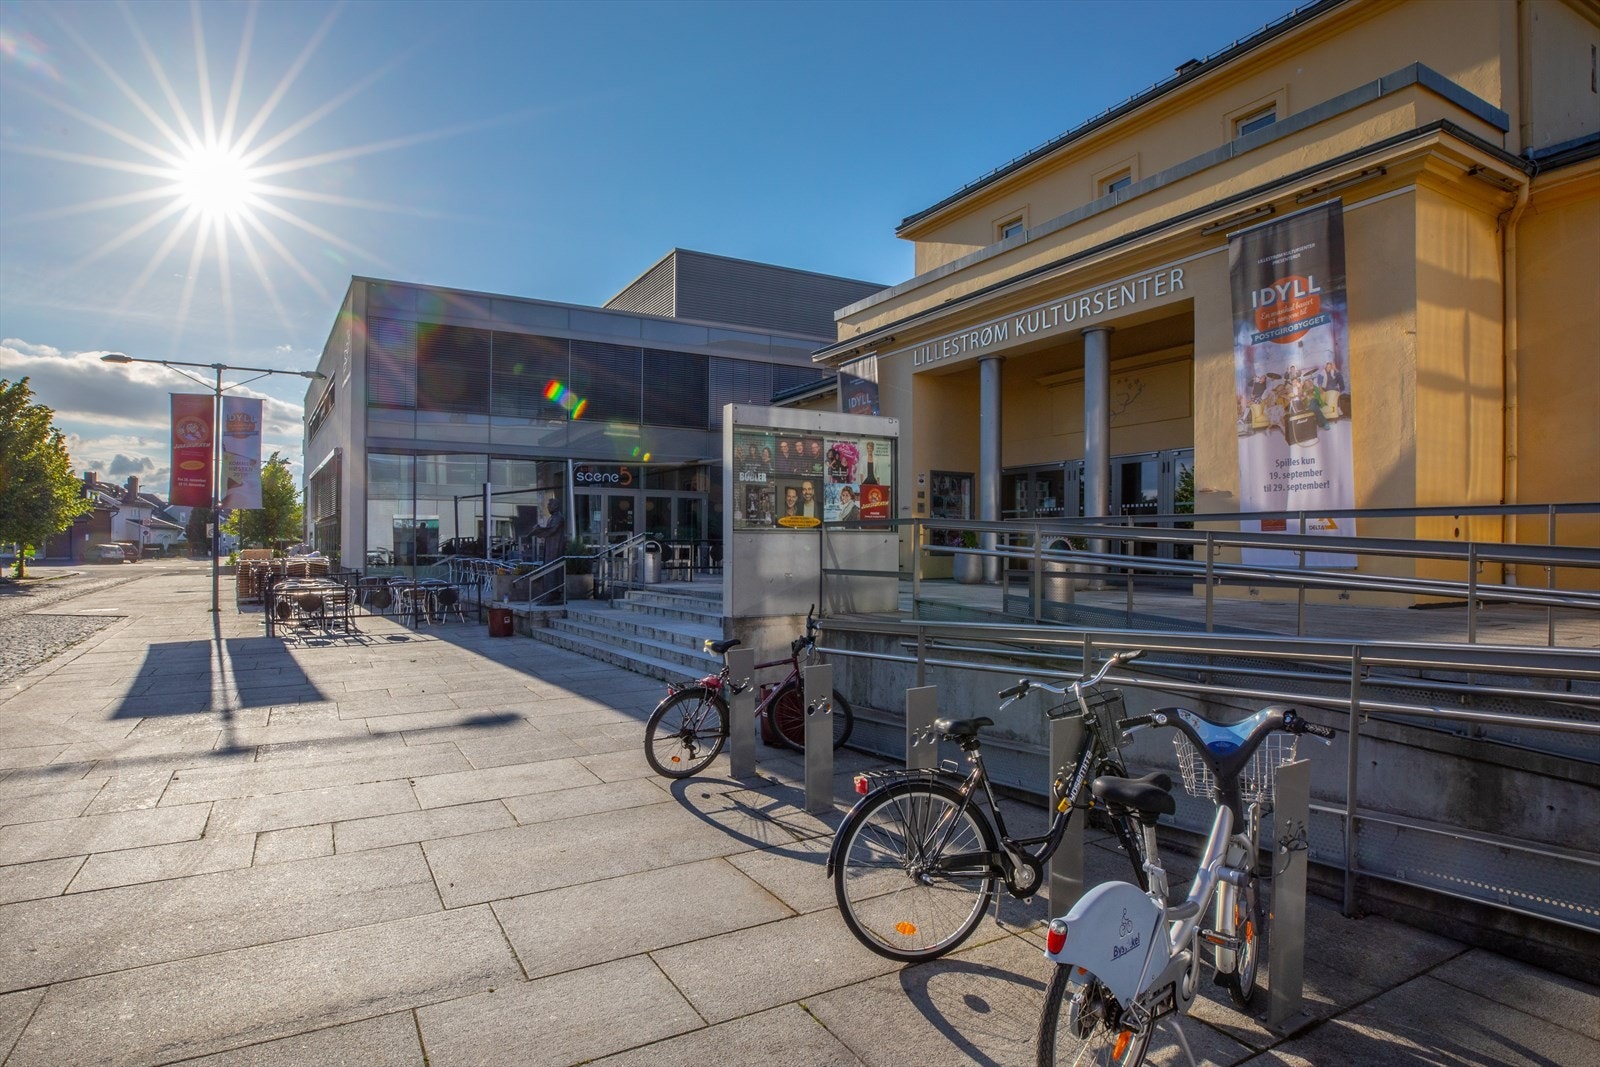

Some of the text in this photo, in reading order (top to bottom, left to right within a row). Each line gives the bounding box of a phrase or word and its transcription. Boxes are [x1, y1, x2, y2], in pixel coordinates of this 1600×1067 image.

[1252, 275, 1321, 308] IDYLL
[913, 268, 1185, 367] LILLESTRØM KULTURSENTER
[1254, 314, 1325, 342] POSTGIROBYGGET
[848, 393, 872, 408] IDYLL
[1275, 457, 1315, 469] Spilles kun
[1269, 469, 1323, 480] 19. september
[1263, 480, 1330, 493] til 29. september!
